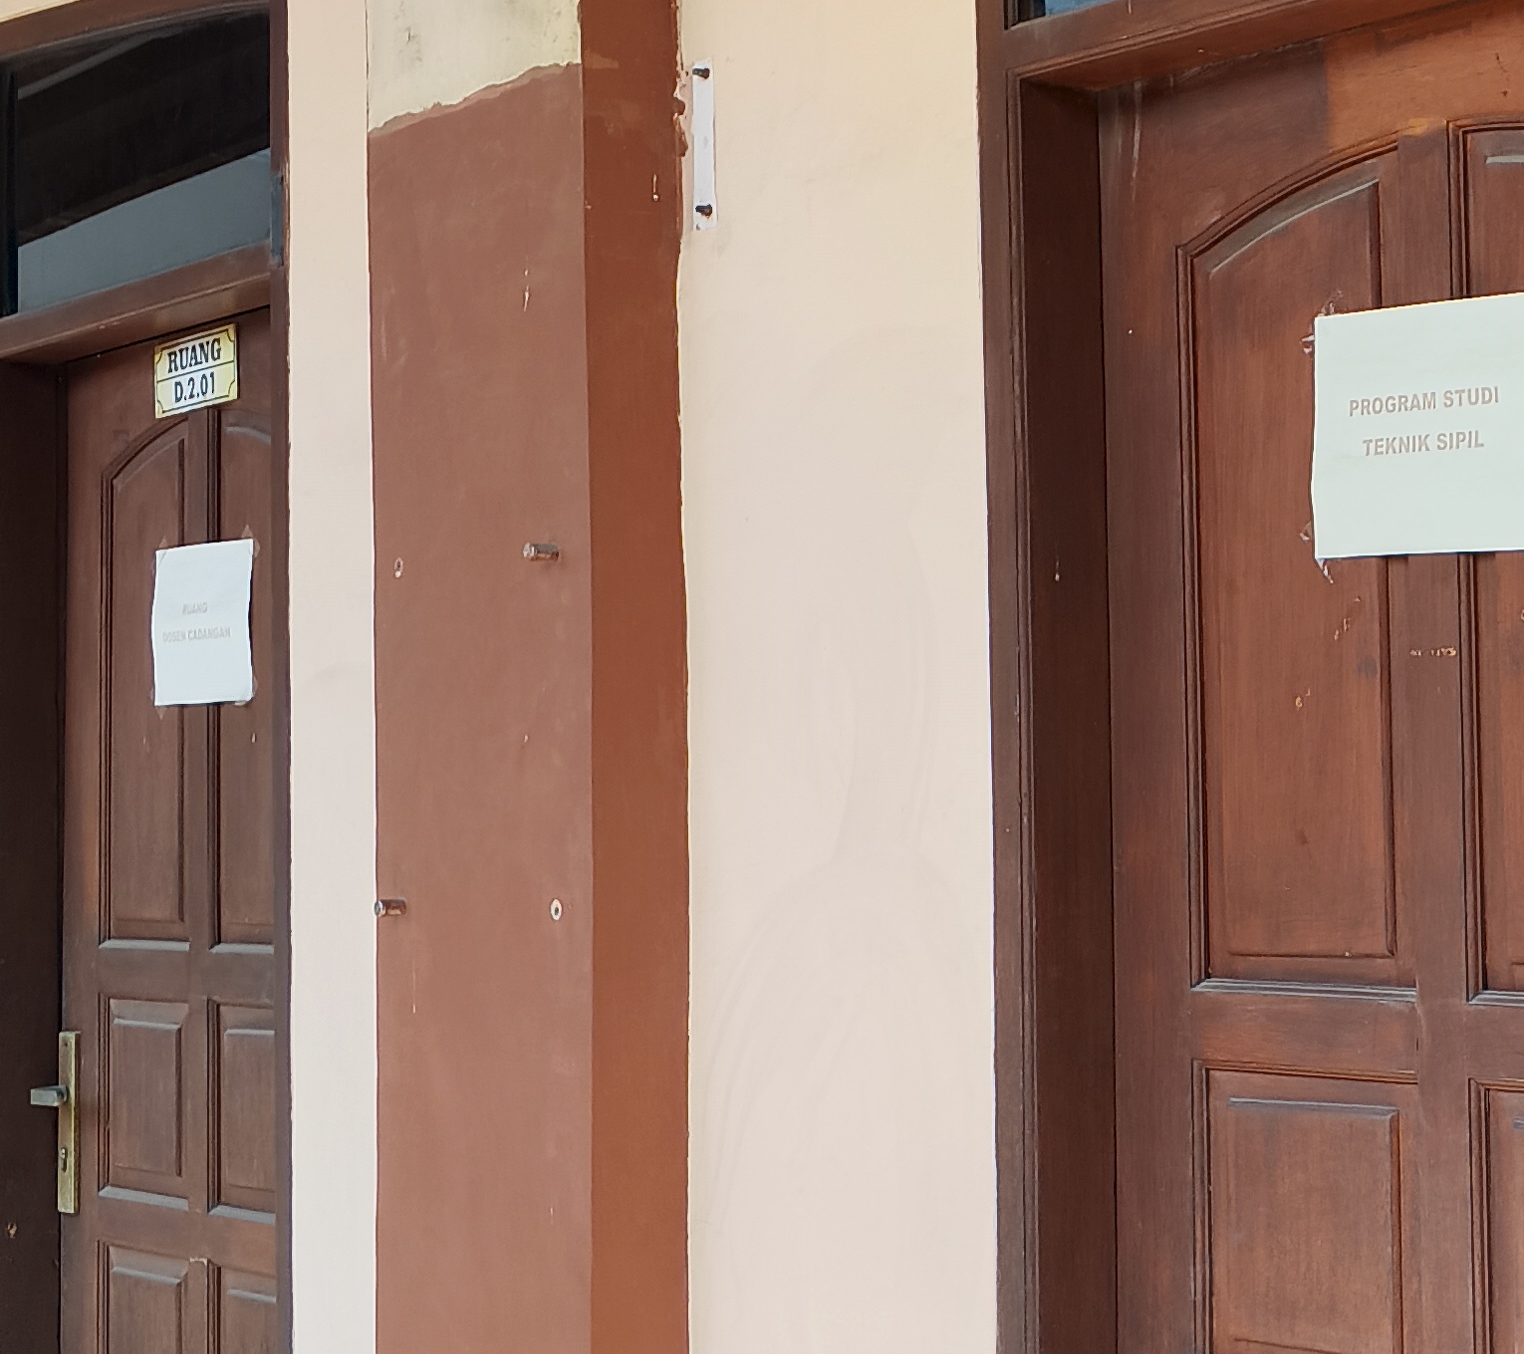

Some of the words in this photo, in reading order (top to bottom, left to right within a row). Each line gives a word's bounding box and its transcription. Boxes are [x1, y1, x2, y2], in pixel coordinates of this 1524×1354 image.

[167, 338, 222, 373] RUANG
[174, 372, 215, 403] D.2.01
[1348, 391, 1437, 418] PROGRAM
[1443, 386, 1499, 408] STUDI
[1361, 433, 1431, 457] TEKNIK
[1435, 429, 1485, 451] SIPIL
